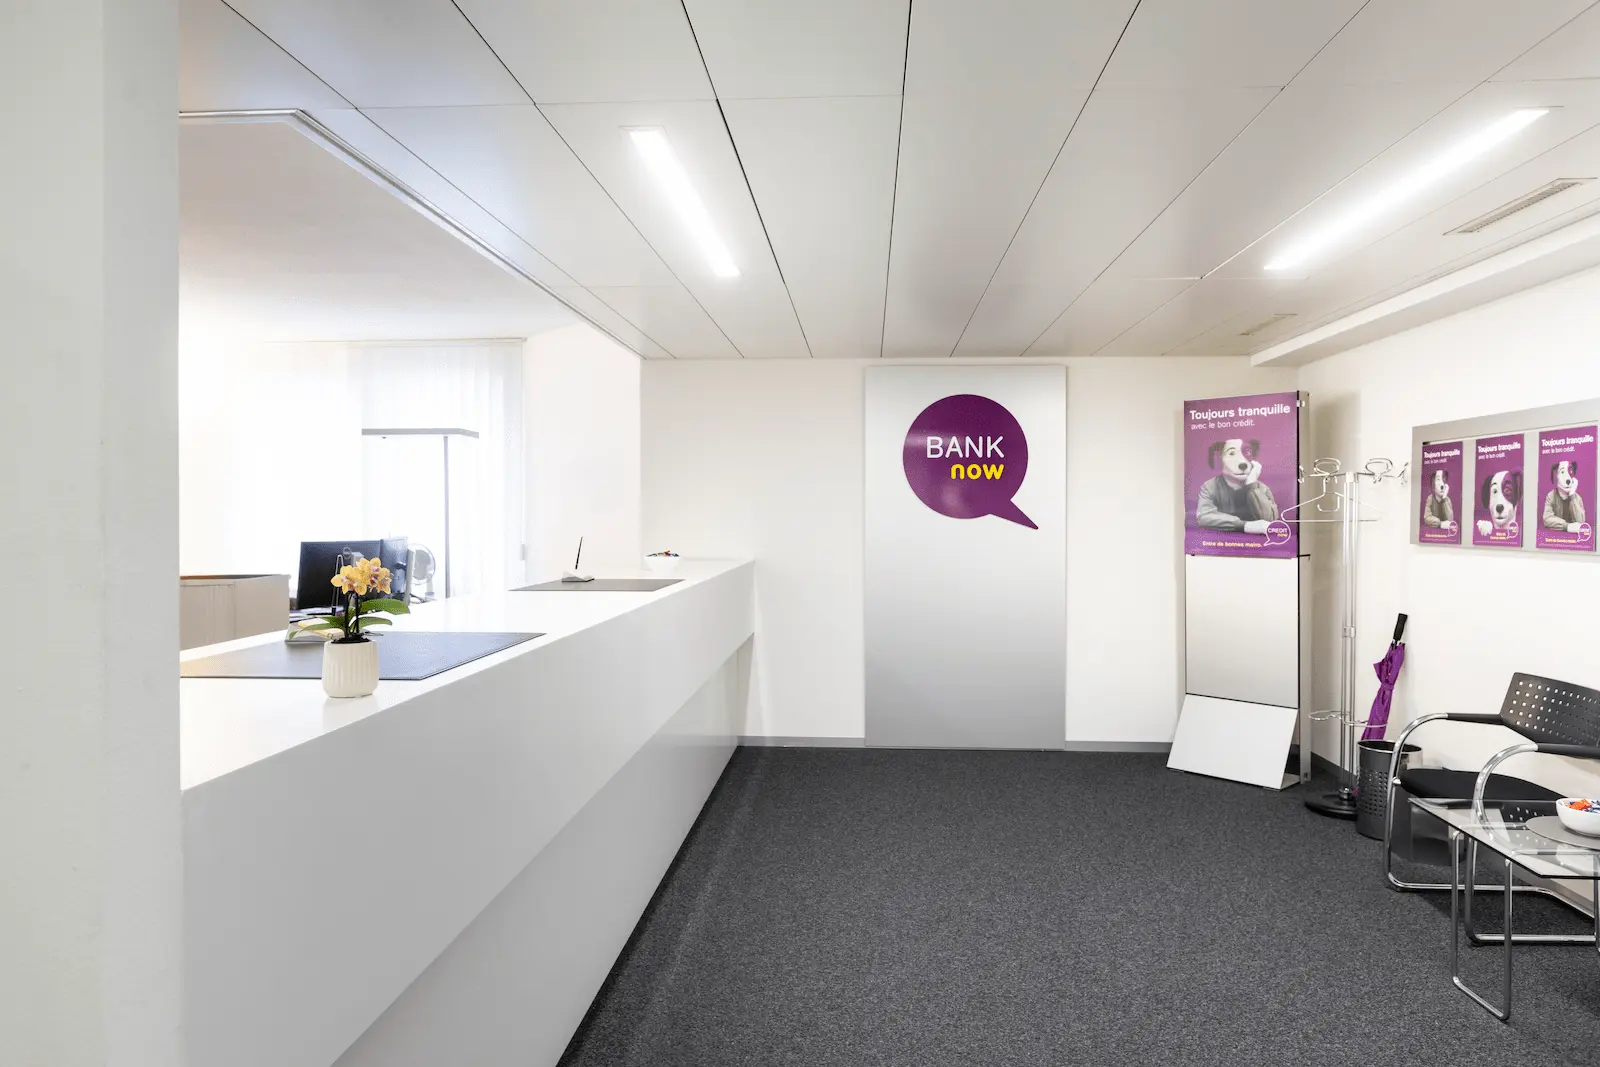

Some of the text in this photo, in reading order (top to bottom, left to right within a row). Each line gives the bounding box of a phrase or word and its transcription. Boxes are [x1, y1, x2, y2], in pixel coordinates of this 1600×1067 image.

[1189, 403, 1291, 421] Toujours tranquille
[1217, 421, 1231, 429] bon
[926, 435, 1005, 459] BANK
[1541, 434, 1594, 447] Toujours tranquille
[1478, 445, 1498, 453] Toujours
[950, 463, 1005, 480] now
